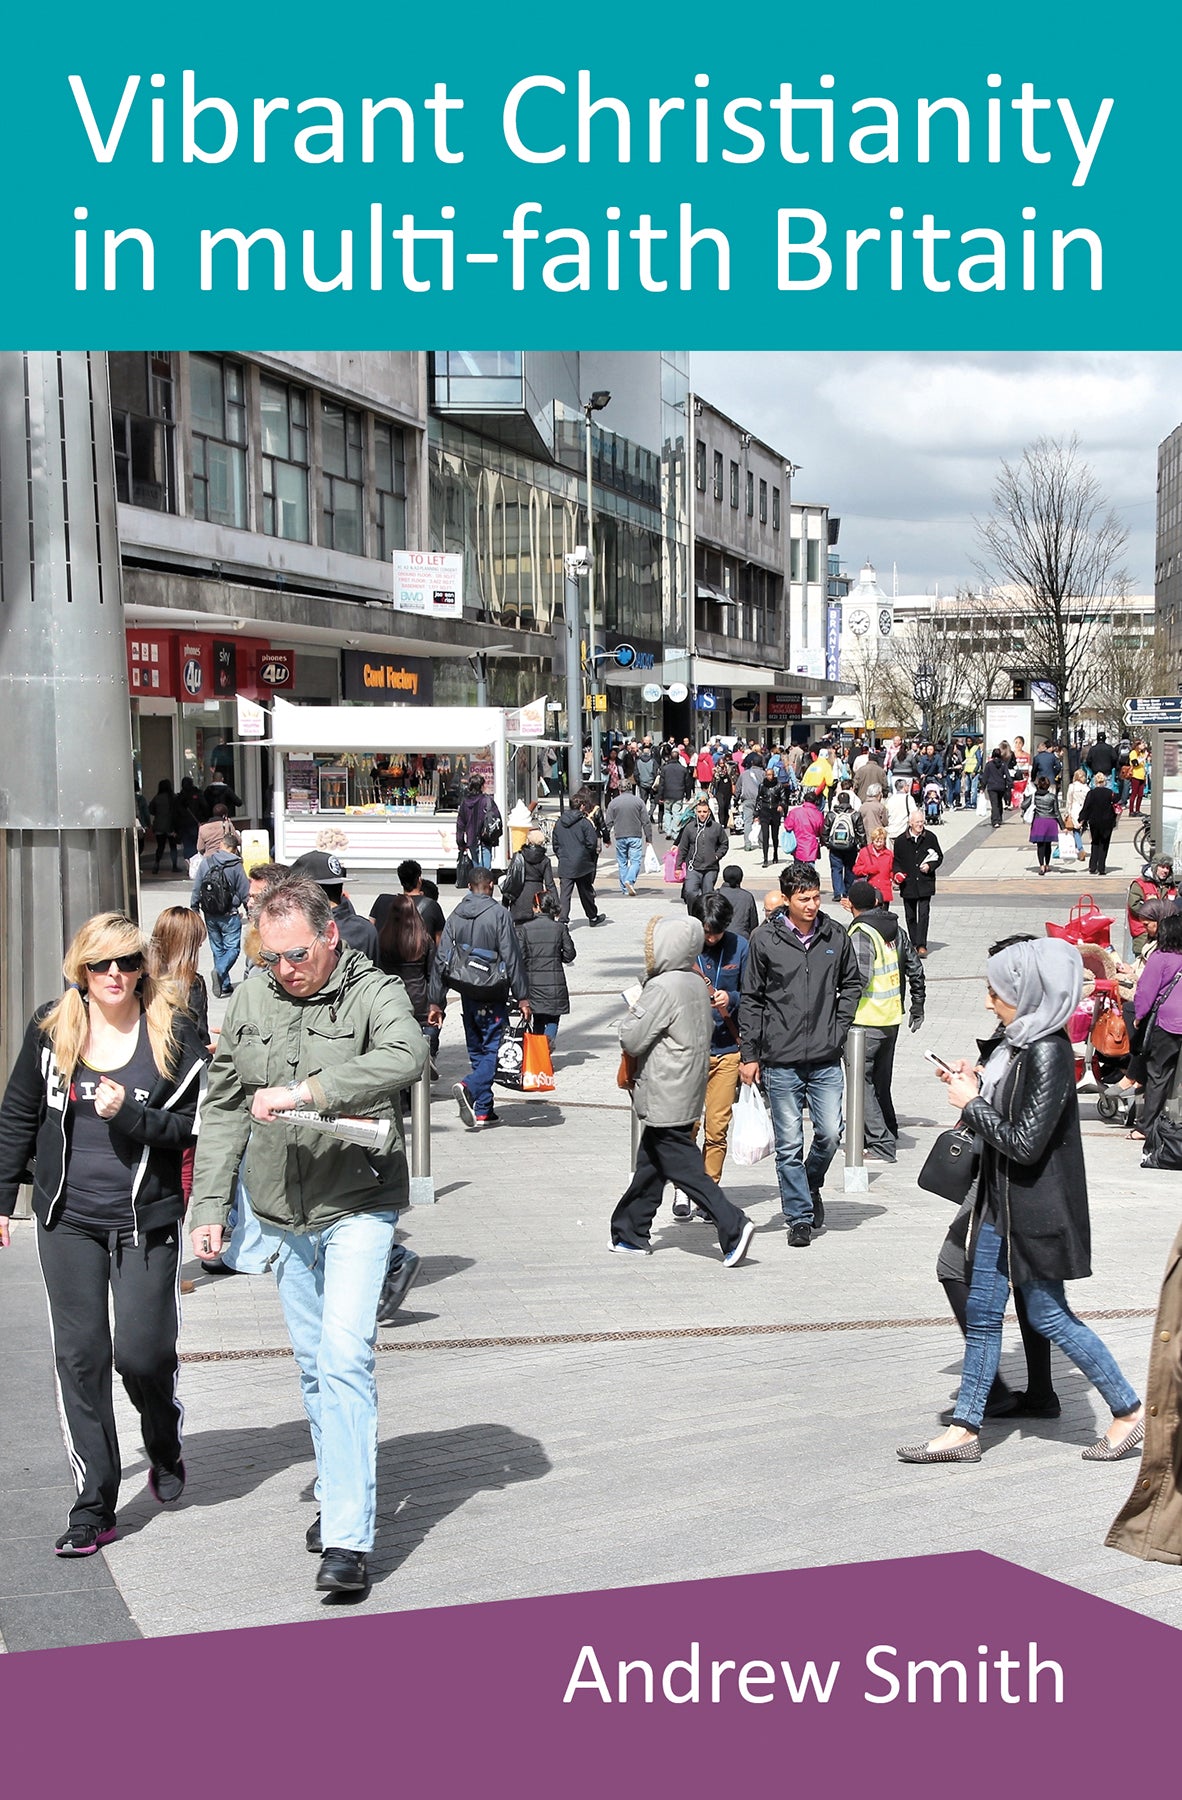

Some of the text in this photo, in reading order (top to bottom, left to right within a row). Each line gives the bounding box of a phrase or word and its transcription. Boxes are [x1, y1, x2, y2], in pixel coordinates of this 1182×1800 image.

[409, 554, 446, 566] TO LET
[184, 644, 201, 657] phones
[829, 610, 838, 681] BRANTANO
[219, 648, 231, 666] sky
[261, 654, 288, 663] phones
[186, 661, 202, 694] 4u
[263, 664, 286, 683] 4u
[363, 664, 419, 695] Card Factory
